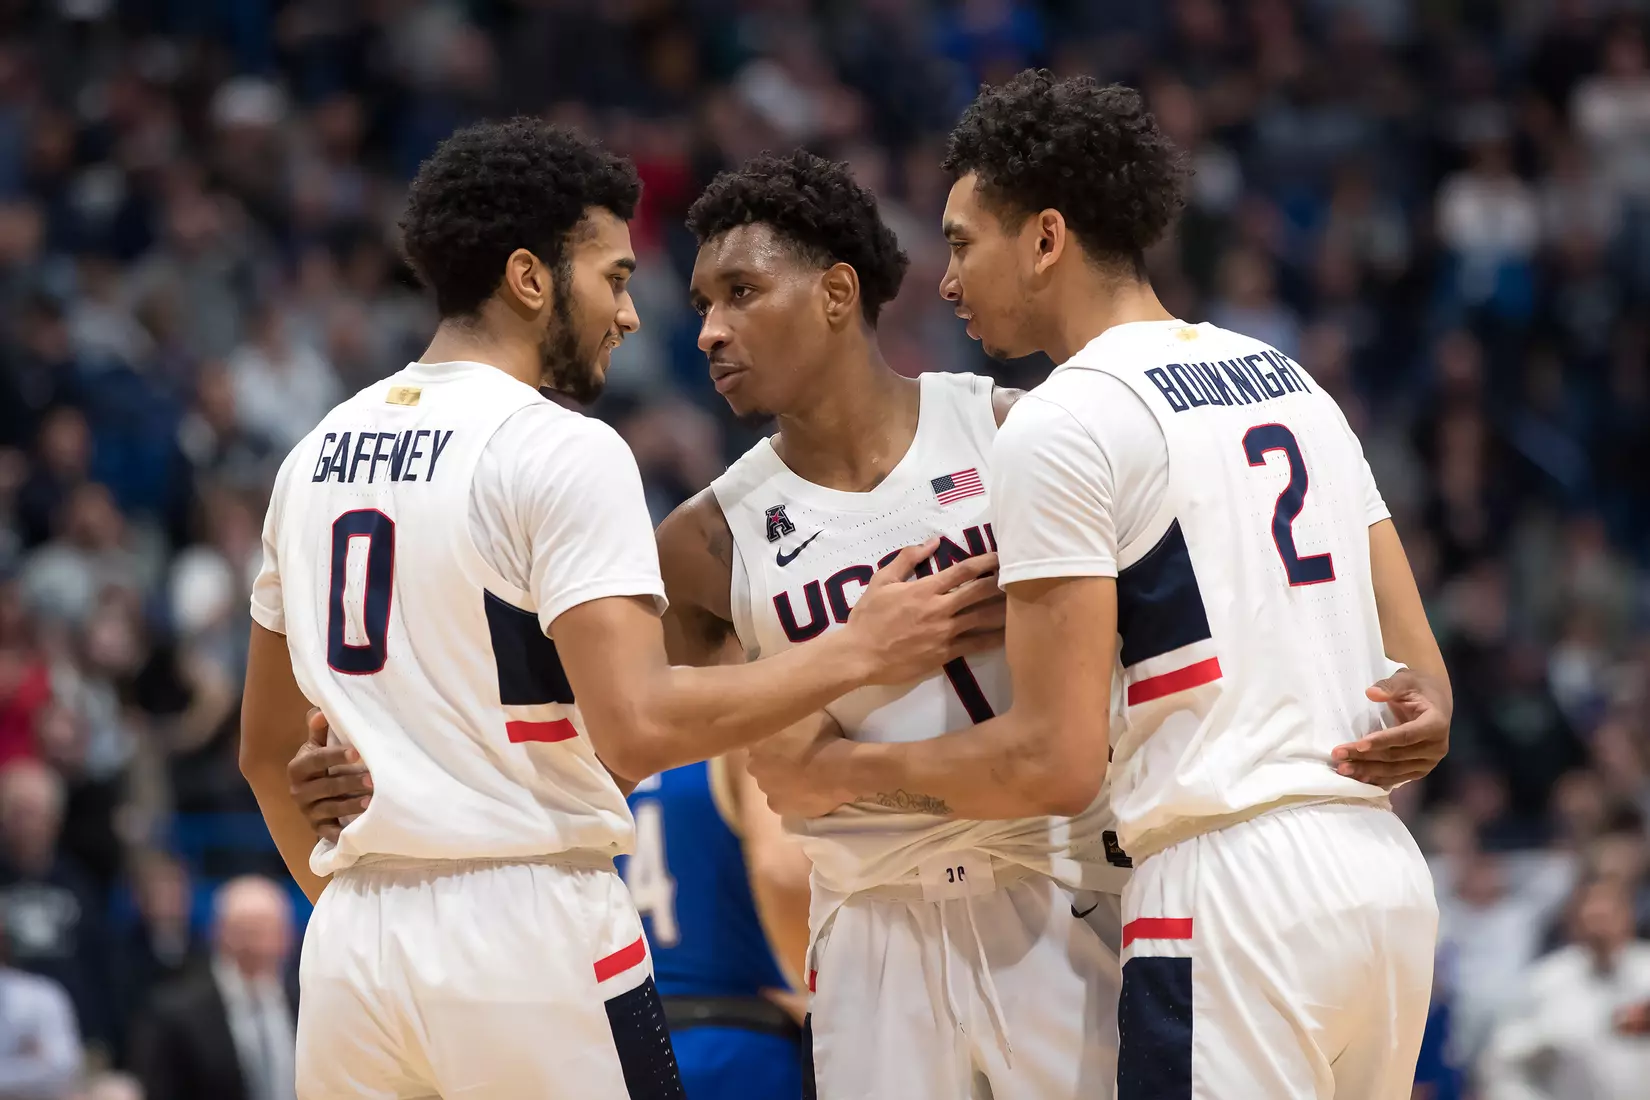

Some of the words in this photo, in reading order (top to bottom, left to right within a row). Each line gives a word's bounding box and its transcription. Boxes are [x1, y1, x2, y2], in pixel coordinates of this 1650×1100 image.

[311, 430, 454, 484] GAFFNEY
[1242, 422, 1336, 587] 2
[327, 508, 396, 676] 0
